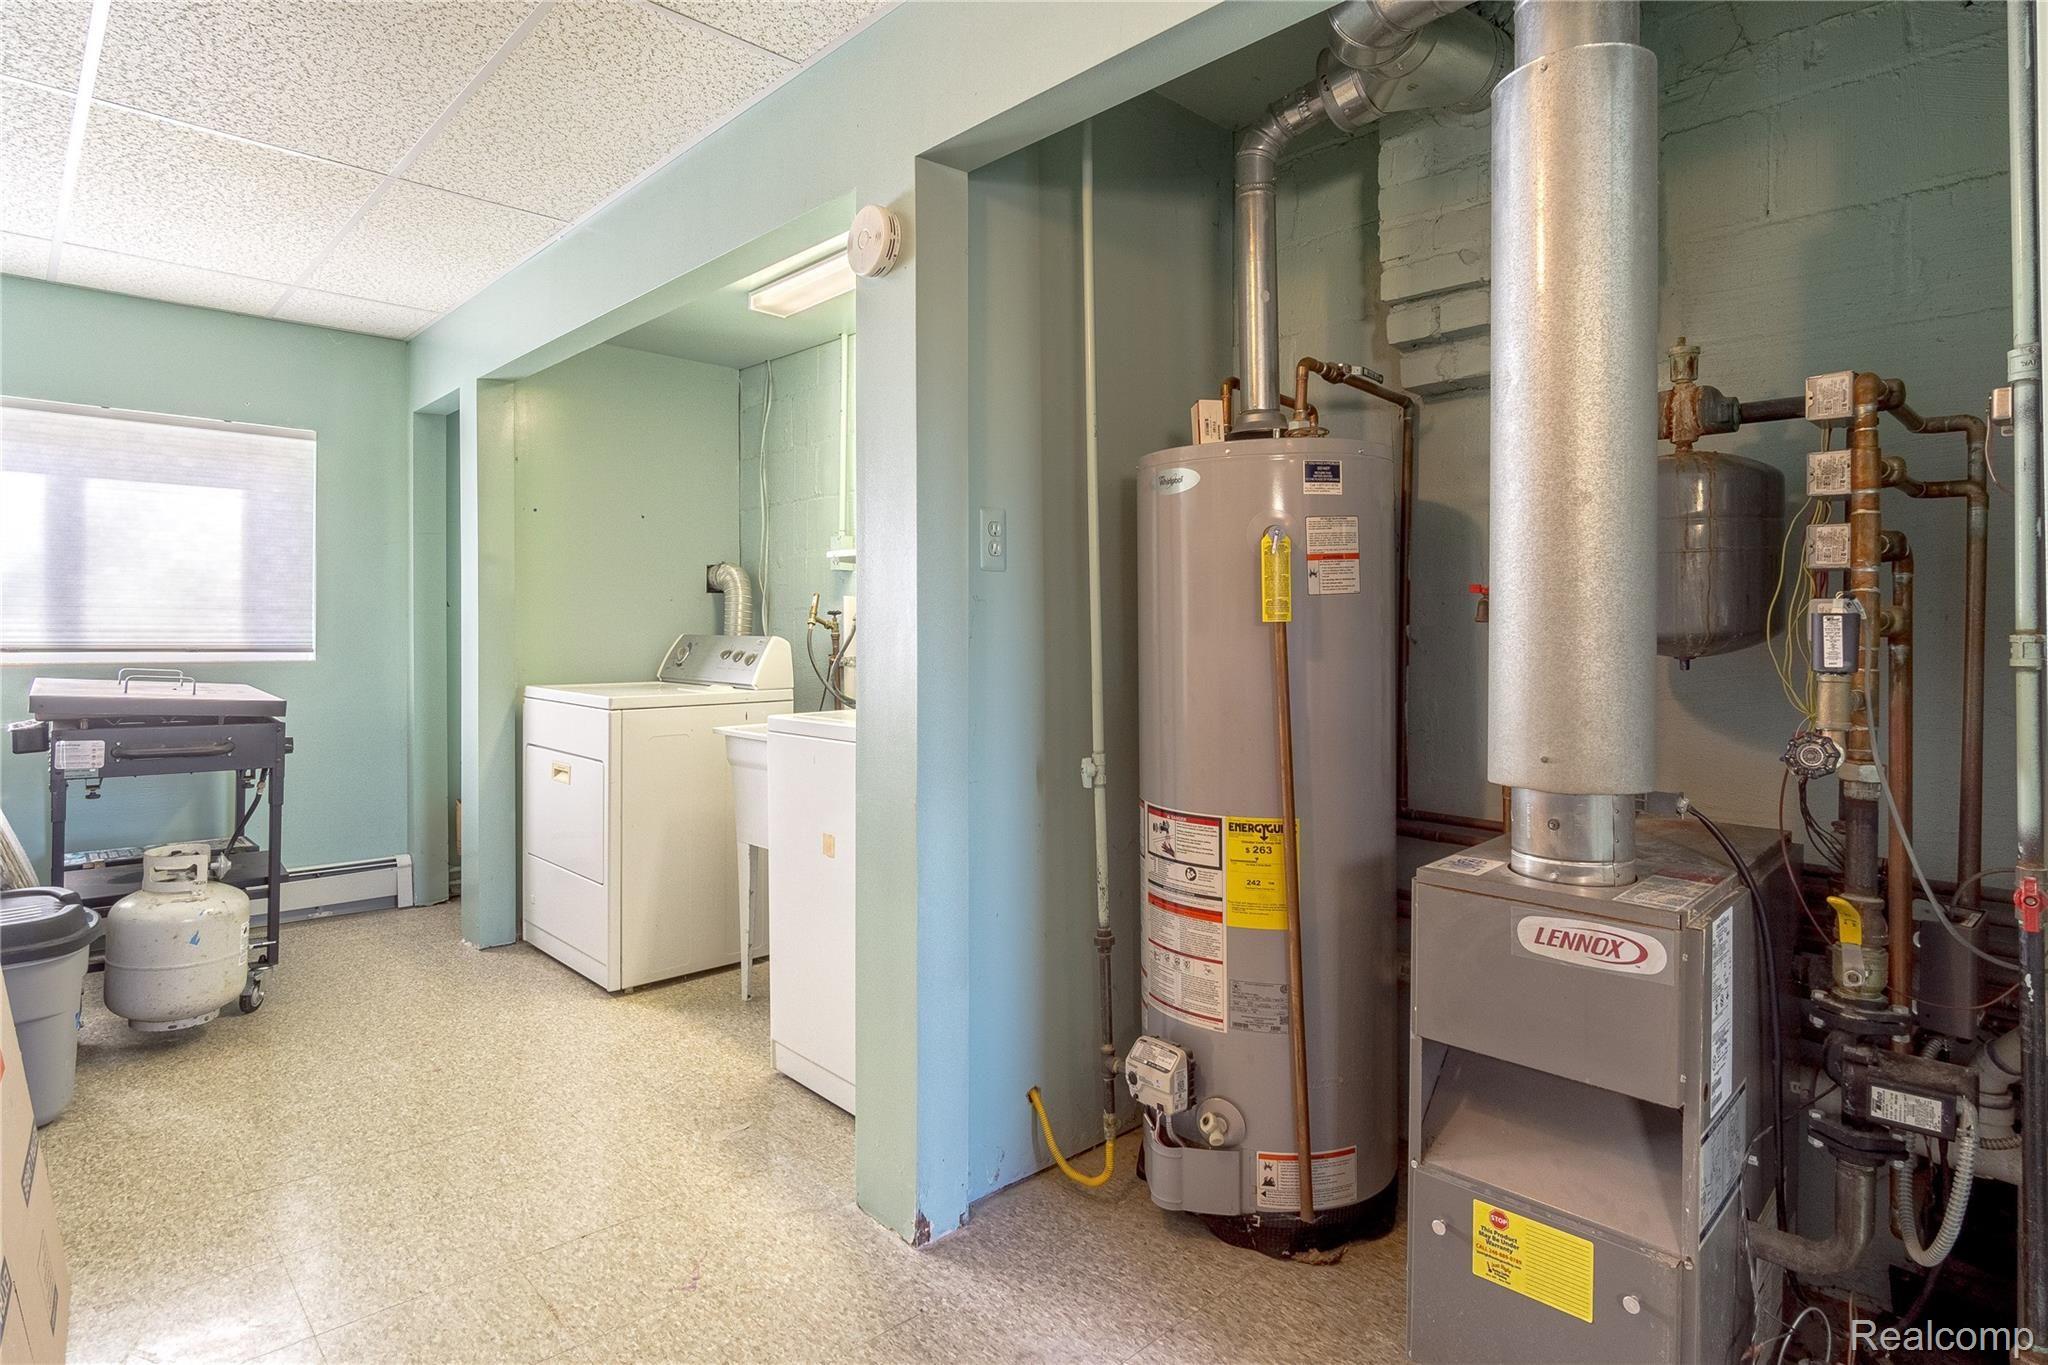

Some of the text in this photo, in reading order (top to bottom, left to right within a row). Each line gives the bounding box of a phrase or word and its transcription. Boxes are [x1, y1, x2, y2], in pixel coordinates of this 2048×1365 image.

[1252, 845, 1273, 855] 263
[1534, 926, 1625, 959] LENNOX
[1490, 1214, 1508, 1225] STOP
[1478, 1230, 1520, 1250] May Be Under
[1480, 1225, 1518, 1244] This Product
[1485, 1239, 1514, 1255] Warranty
